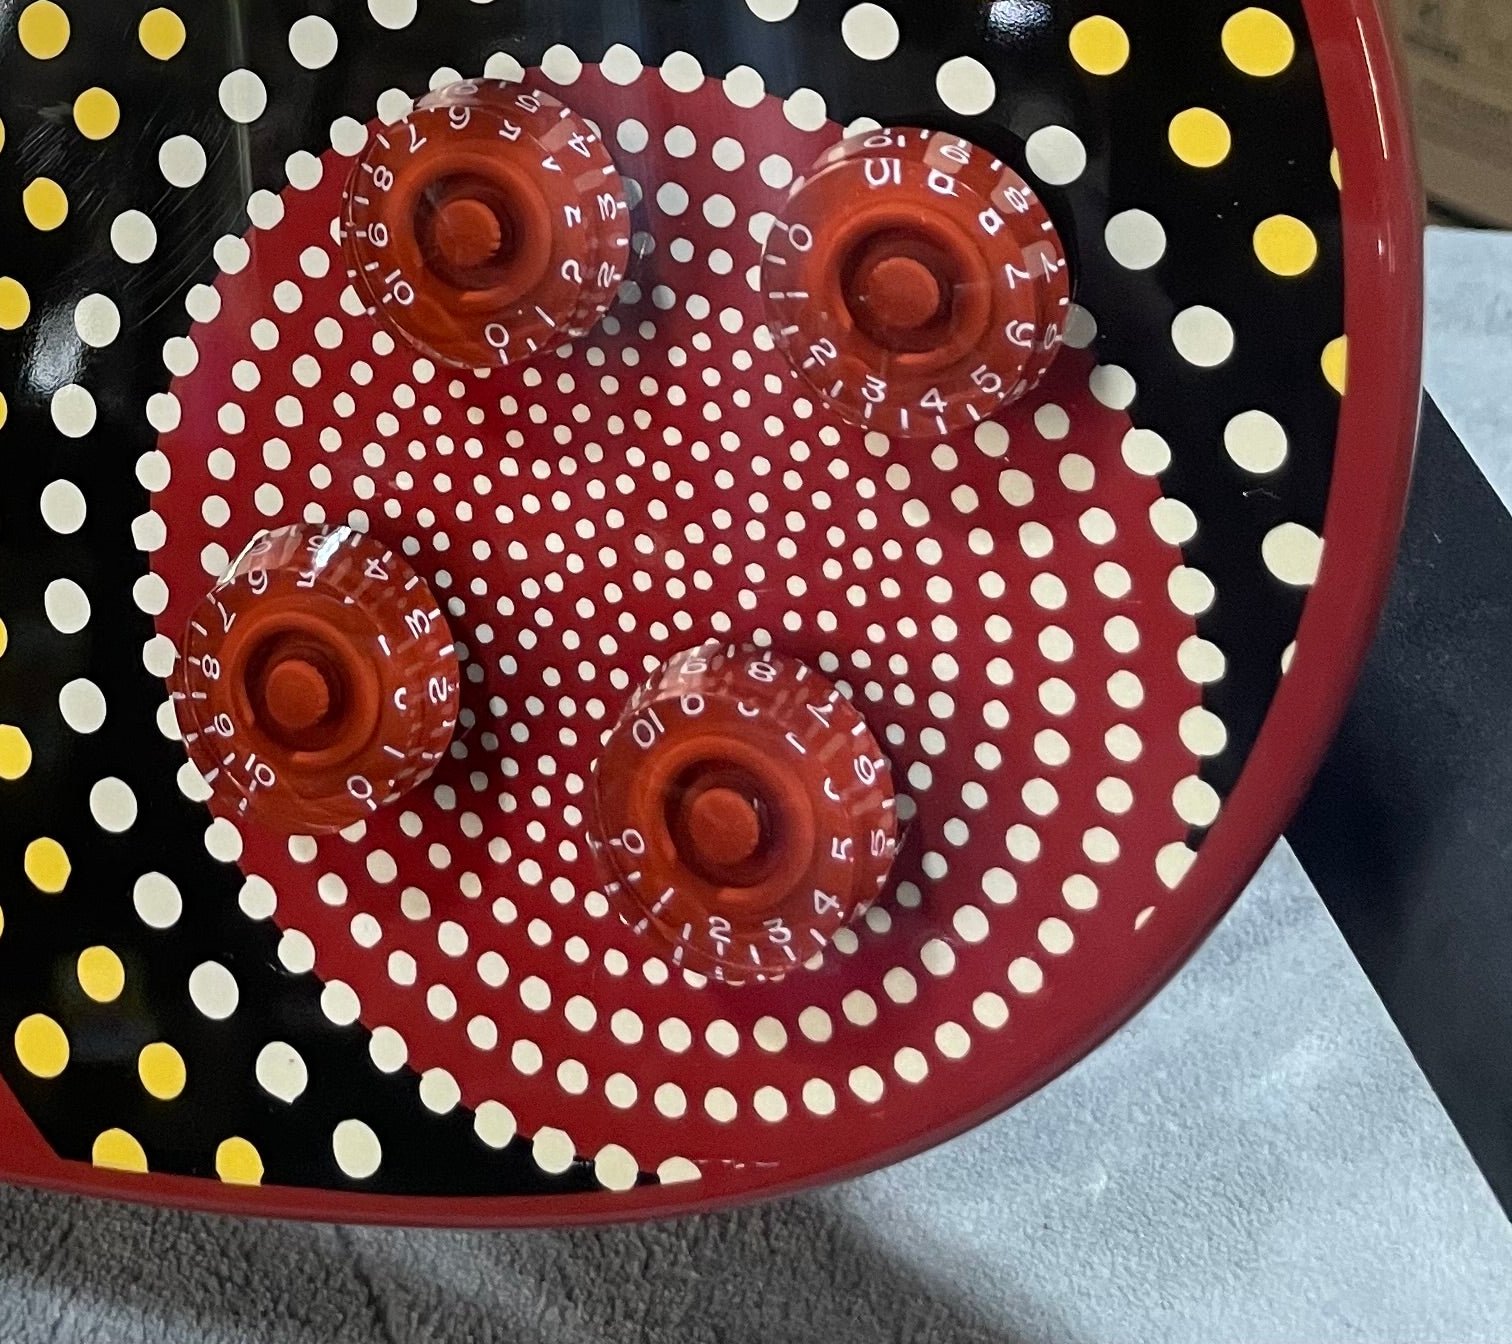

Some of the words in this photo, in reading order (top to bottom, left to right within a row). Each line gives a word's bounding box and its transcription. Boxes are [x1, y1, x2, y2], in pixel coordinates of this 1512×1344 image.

[409, 124, 426, 153] 7
[568, 132, 590, 158] 4
[373, 165, 393, 191] 8
[597, 193, 617, 221] 3
[385, 269, 414, 305] 10
[810, 338, 836, 366] 2
[861, 375, 887, 402] 3
[920, 388, 947, 412] 4
[971, 365, 1001, 392] 5
[365, 558, 388, 581] 4
[217, 602, 236, 633] 7
[404, 609, 430, 639] 3
[201, 654, 220, 680] 8
[747, 660, 778, 683] 8
[428, 676, 448, 703] 2
[632, 707, 665, 749] 10
[245, 753, 275, 787] 10
[814, 889, 839, 914] 4
[708, 915, 731, 944] 2
[763, 917, 791, 944] 3
